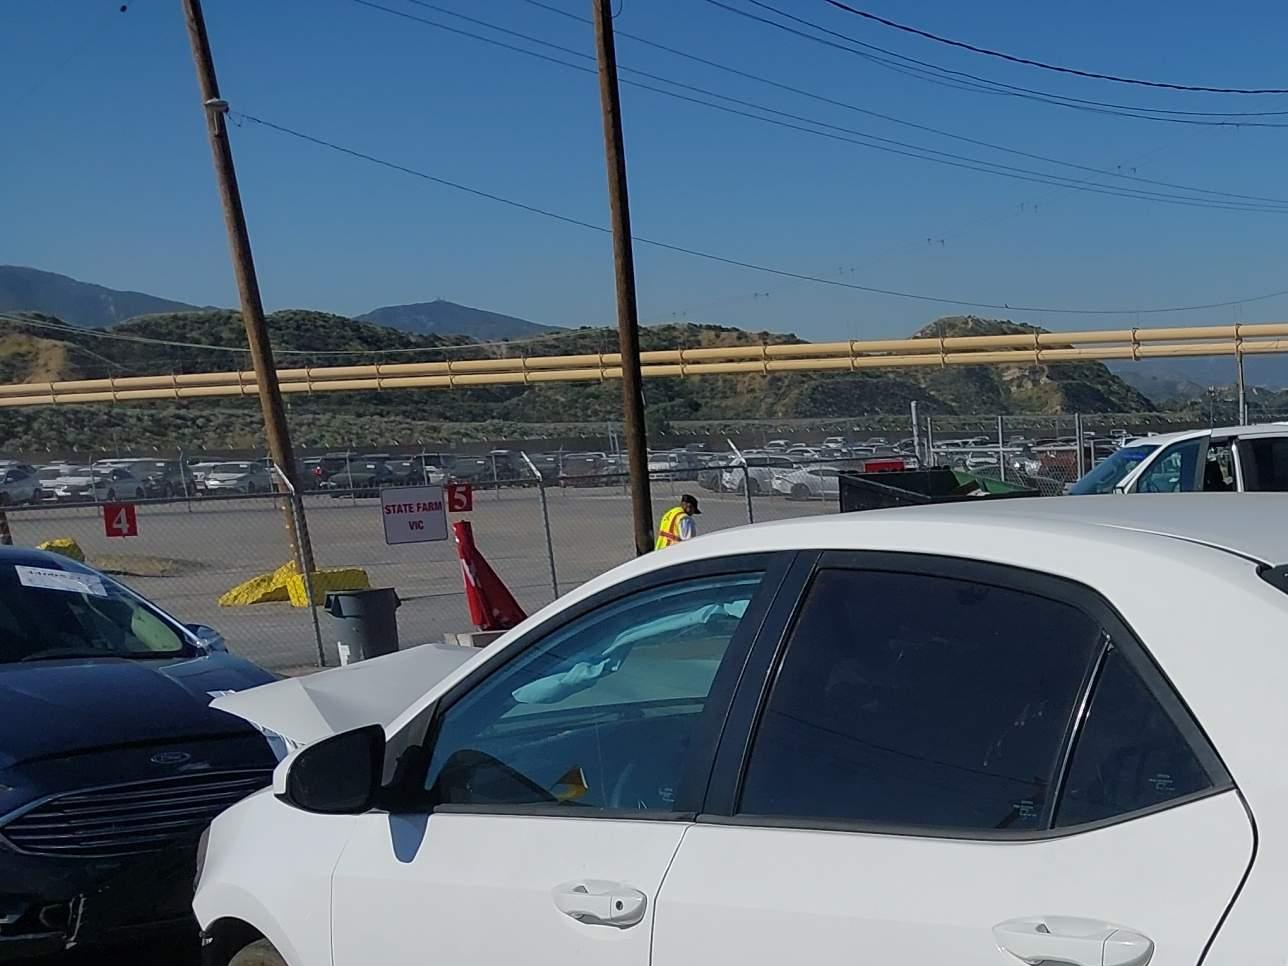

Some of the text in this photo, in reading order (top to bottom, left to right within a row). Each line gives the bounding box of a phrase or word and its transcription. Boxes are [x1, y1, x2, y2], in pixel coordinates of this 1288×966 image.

[453, 485, 467, 510] 5
[384, 501, 442, 514] STATE FARM
[112, 507, 130, 534] 4
[408, 520, 424, 530] VIC
